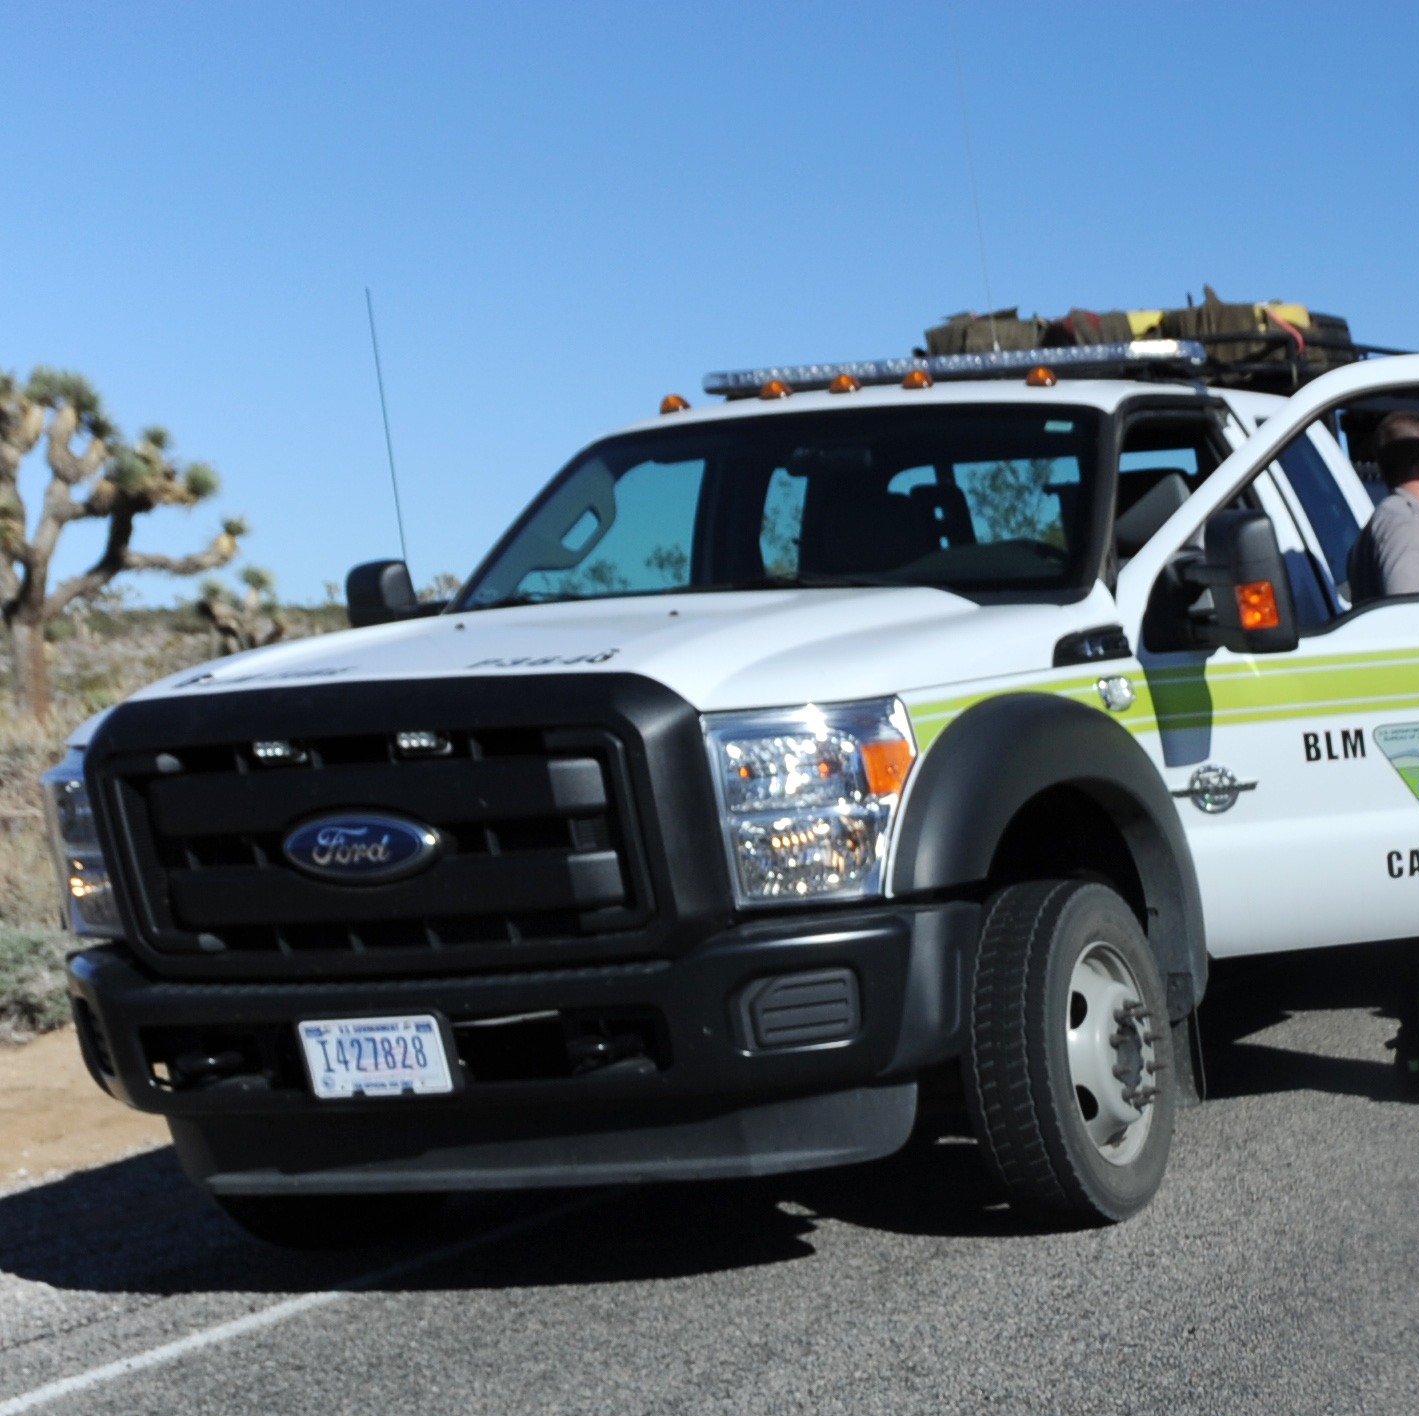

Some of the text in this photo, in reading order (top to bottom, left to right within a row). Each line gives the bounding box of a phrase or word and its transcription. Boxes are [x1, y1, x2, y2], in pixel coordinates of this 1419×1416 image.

[1303, 728, 1367, 762] BLM
[312, 826, 391, 866] Ford
[317, 1035, 428, 1073] I427828
